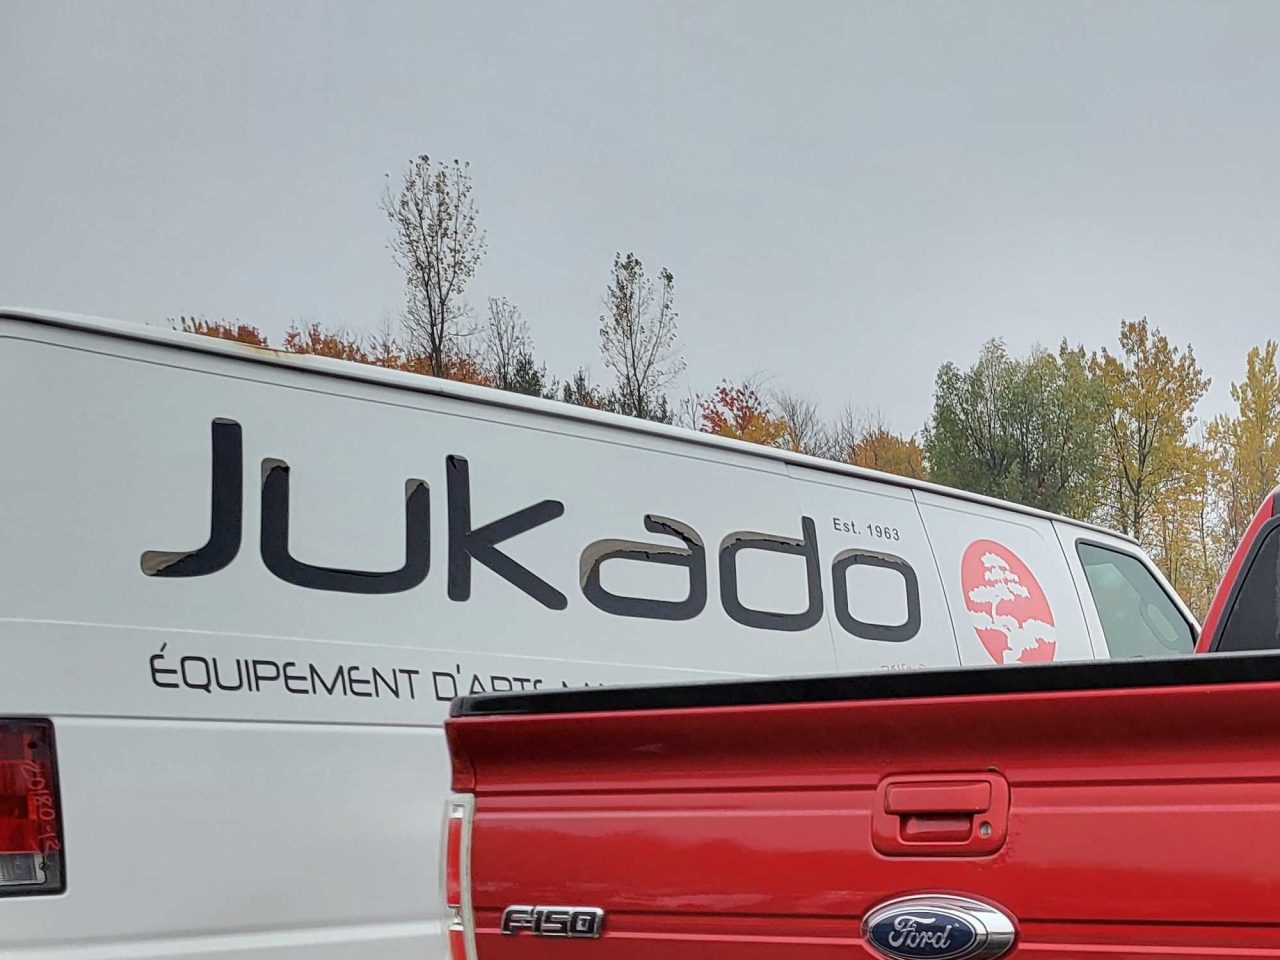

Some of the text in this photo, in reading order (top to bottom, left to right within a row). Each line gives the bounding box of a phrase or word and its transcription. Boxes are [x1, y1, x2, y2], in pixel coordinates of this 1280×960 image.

[141, 417, 921, 642] Jukado
[833, 517, 900, 541] Est. 1963
[149, 643, 420, 700] ÉQUIPEMENT
[888, 915, 953, 949] Ford
